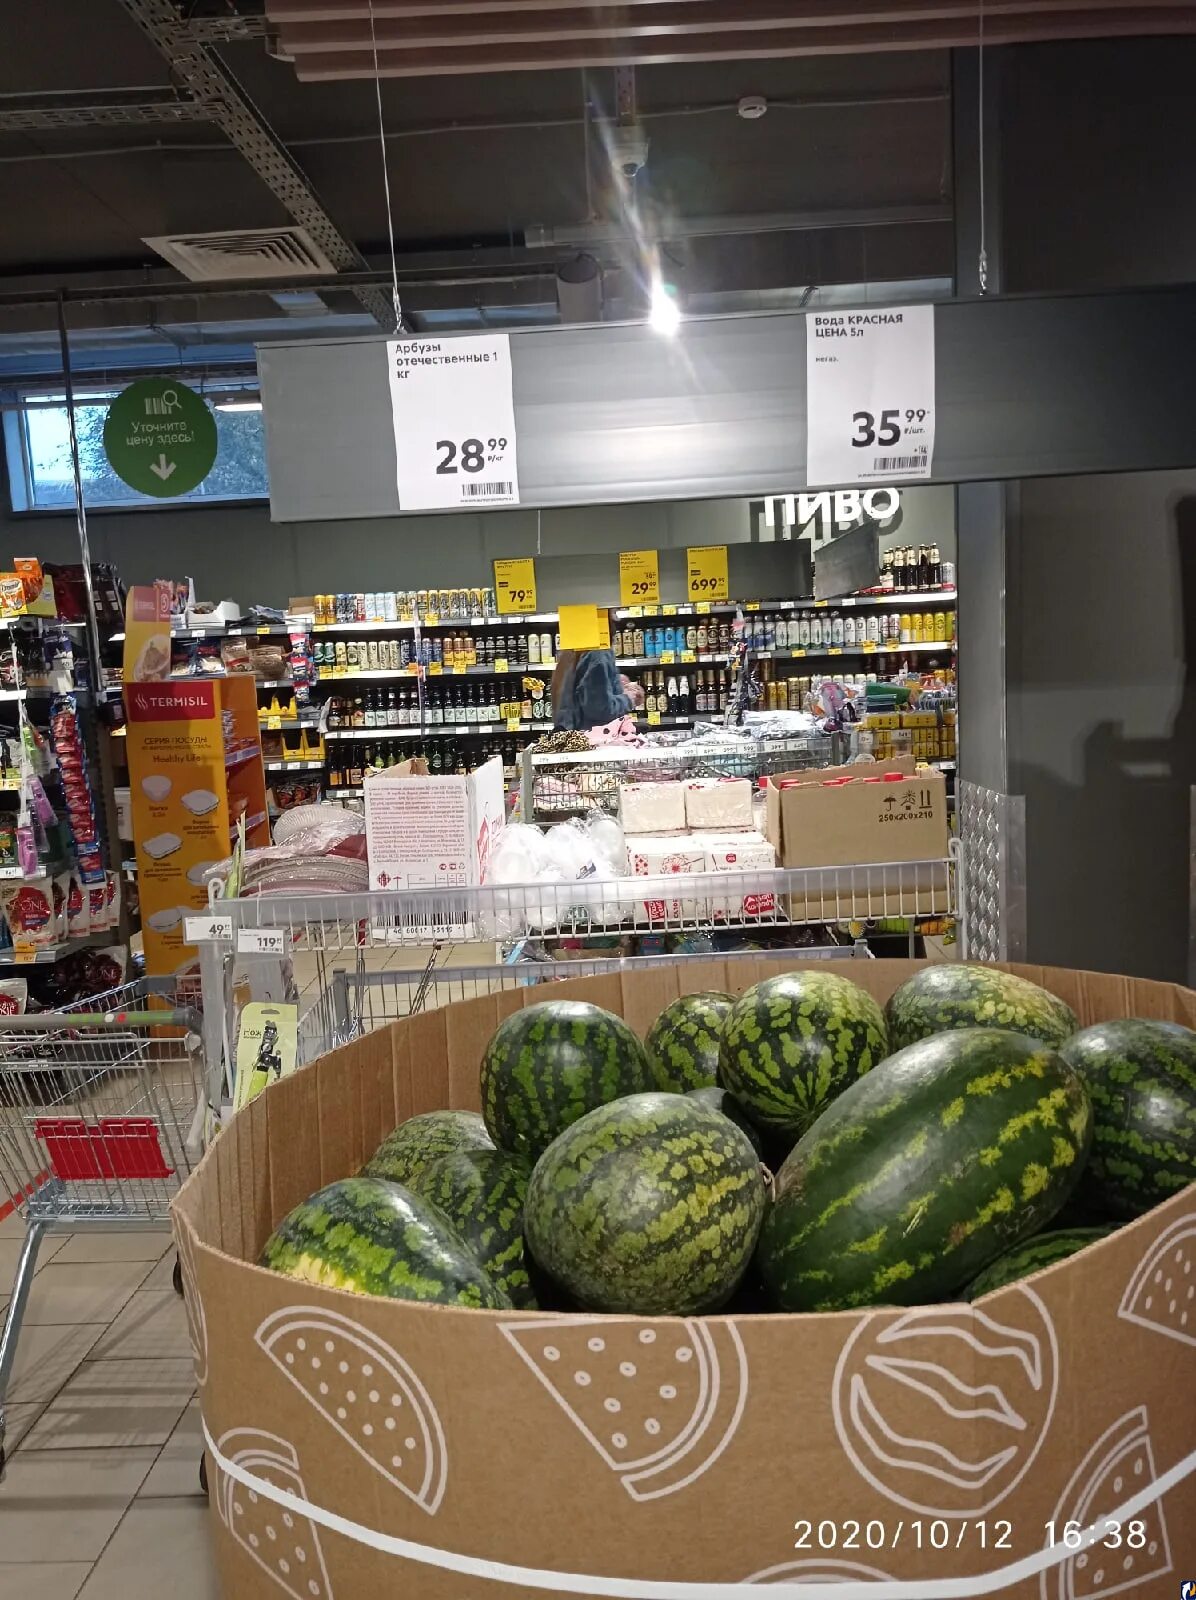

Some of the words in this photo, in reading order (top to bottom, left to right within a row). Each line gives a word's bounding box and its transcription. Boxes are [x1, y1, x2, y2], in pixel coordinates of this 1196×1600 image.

[815, 317, 844, 327] Вода
[848, 314, 903, 325] КРАСНАЯ
[815, 328, 848, 339] ЦЕНА
[850, 328, 864, 337] 5л
[395, 341, 441, 355] Арбузы
[396, 353, 490, 366] отечественные
[492, 351, 498, 361] 1
[397, 370, 410, 379] кг
[130, 421, 187, 433] Уточните
[851, 409, 901, 448] 35
[126, 436, 154, 447] цену
[156, 430, 195, 445] здесь!
[435, 438, 485, 475] 28
[487, 437, 508, 451] 99
[764, 487, 901, 527] ПИВО
[631, 582, 649, 595] 29
[691, 577, 718, 591] 699
[509, 589, 526, 602] 79
[149, 695, 208, 707] TERMISIL
[209, 924, 225, 935] 49
[256, 937, 277, 947] 119
